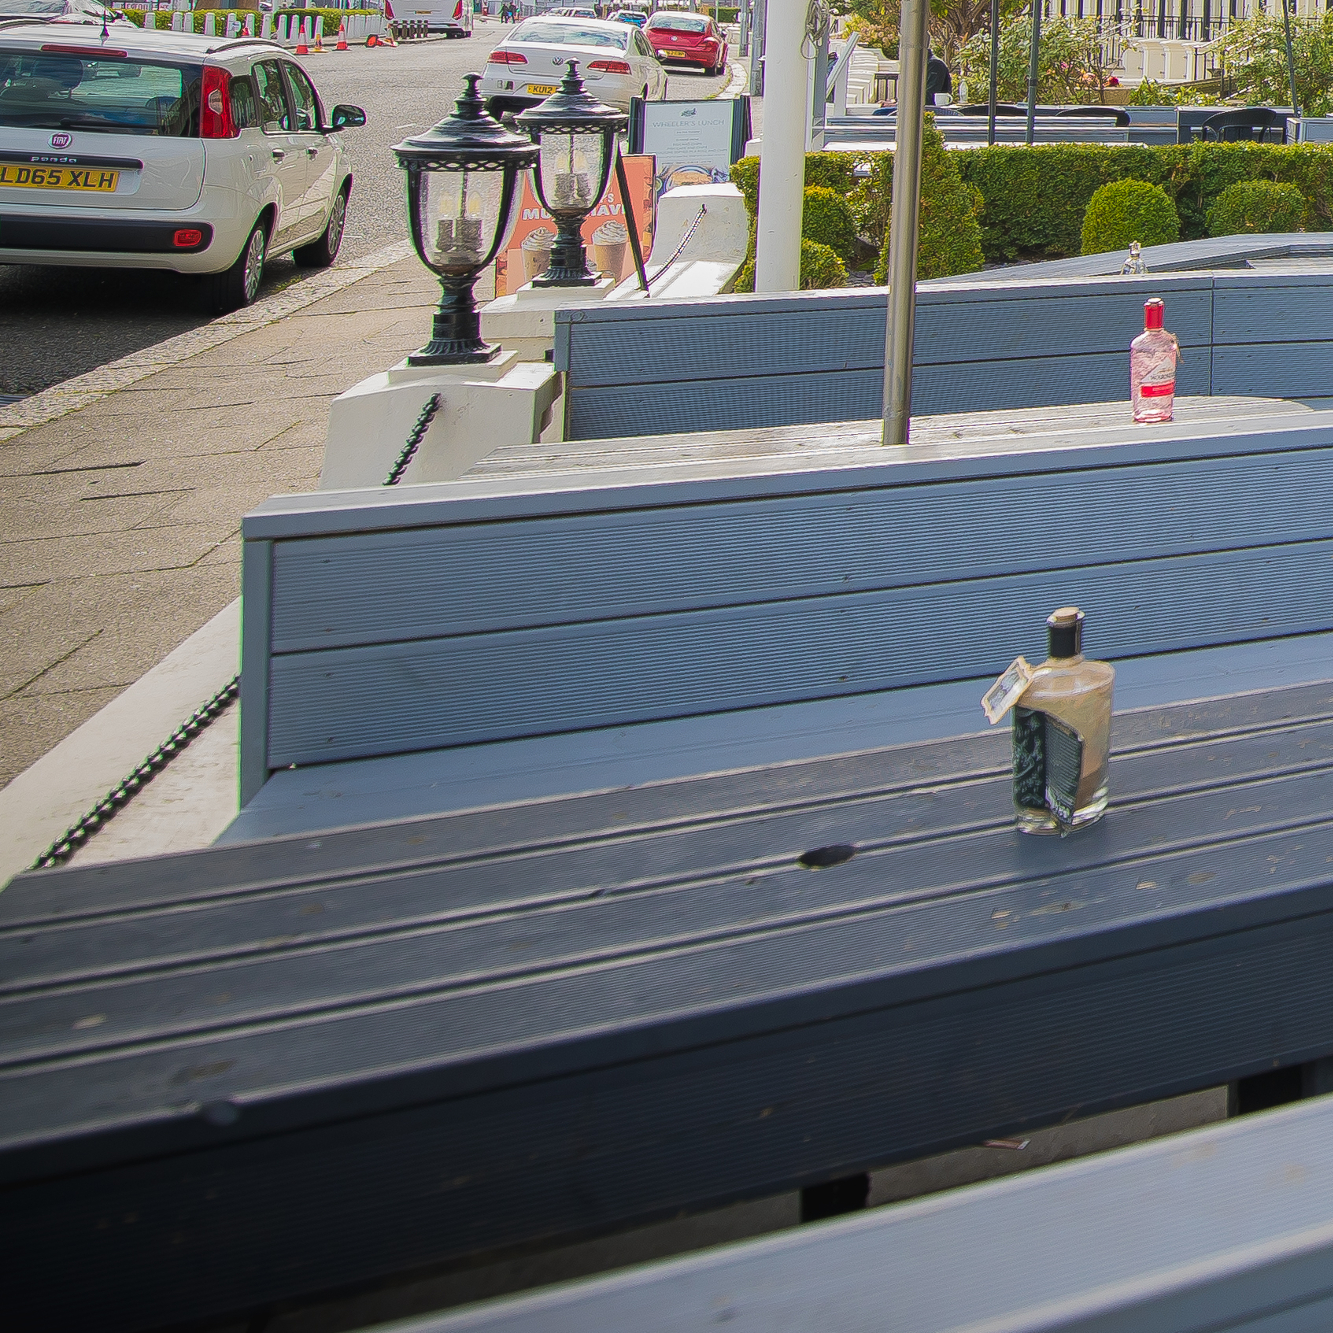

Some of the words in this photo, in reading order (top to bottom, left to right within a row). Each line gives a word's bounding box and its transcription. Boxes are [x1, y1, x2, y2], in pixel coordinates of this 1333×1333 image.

[52, 136, 68, 145] FIAT
[0, 165, 63, 186] LD65
[67, 170, 115, 189] XLH
